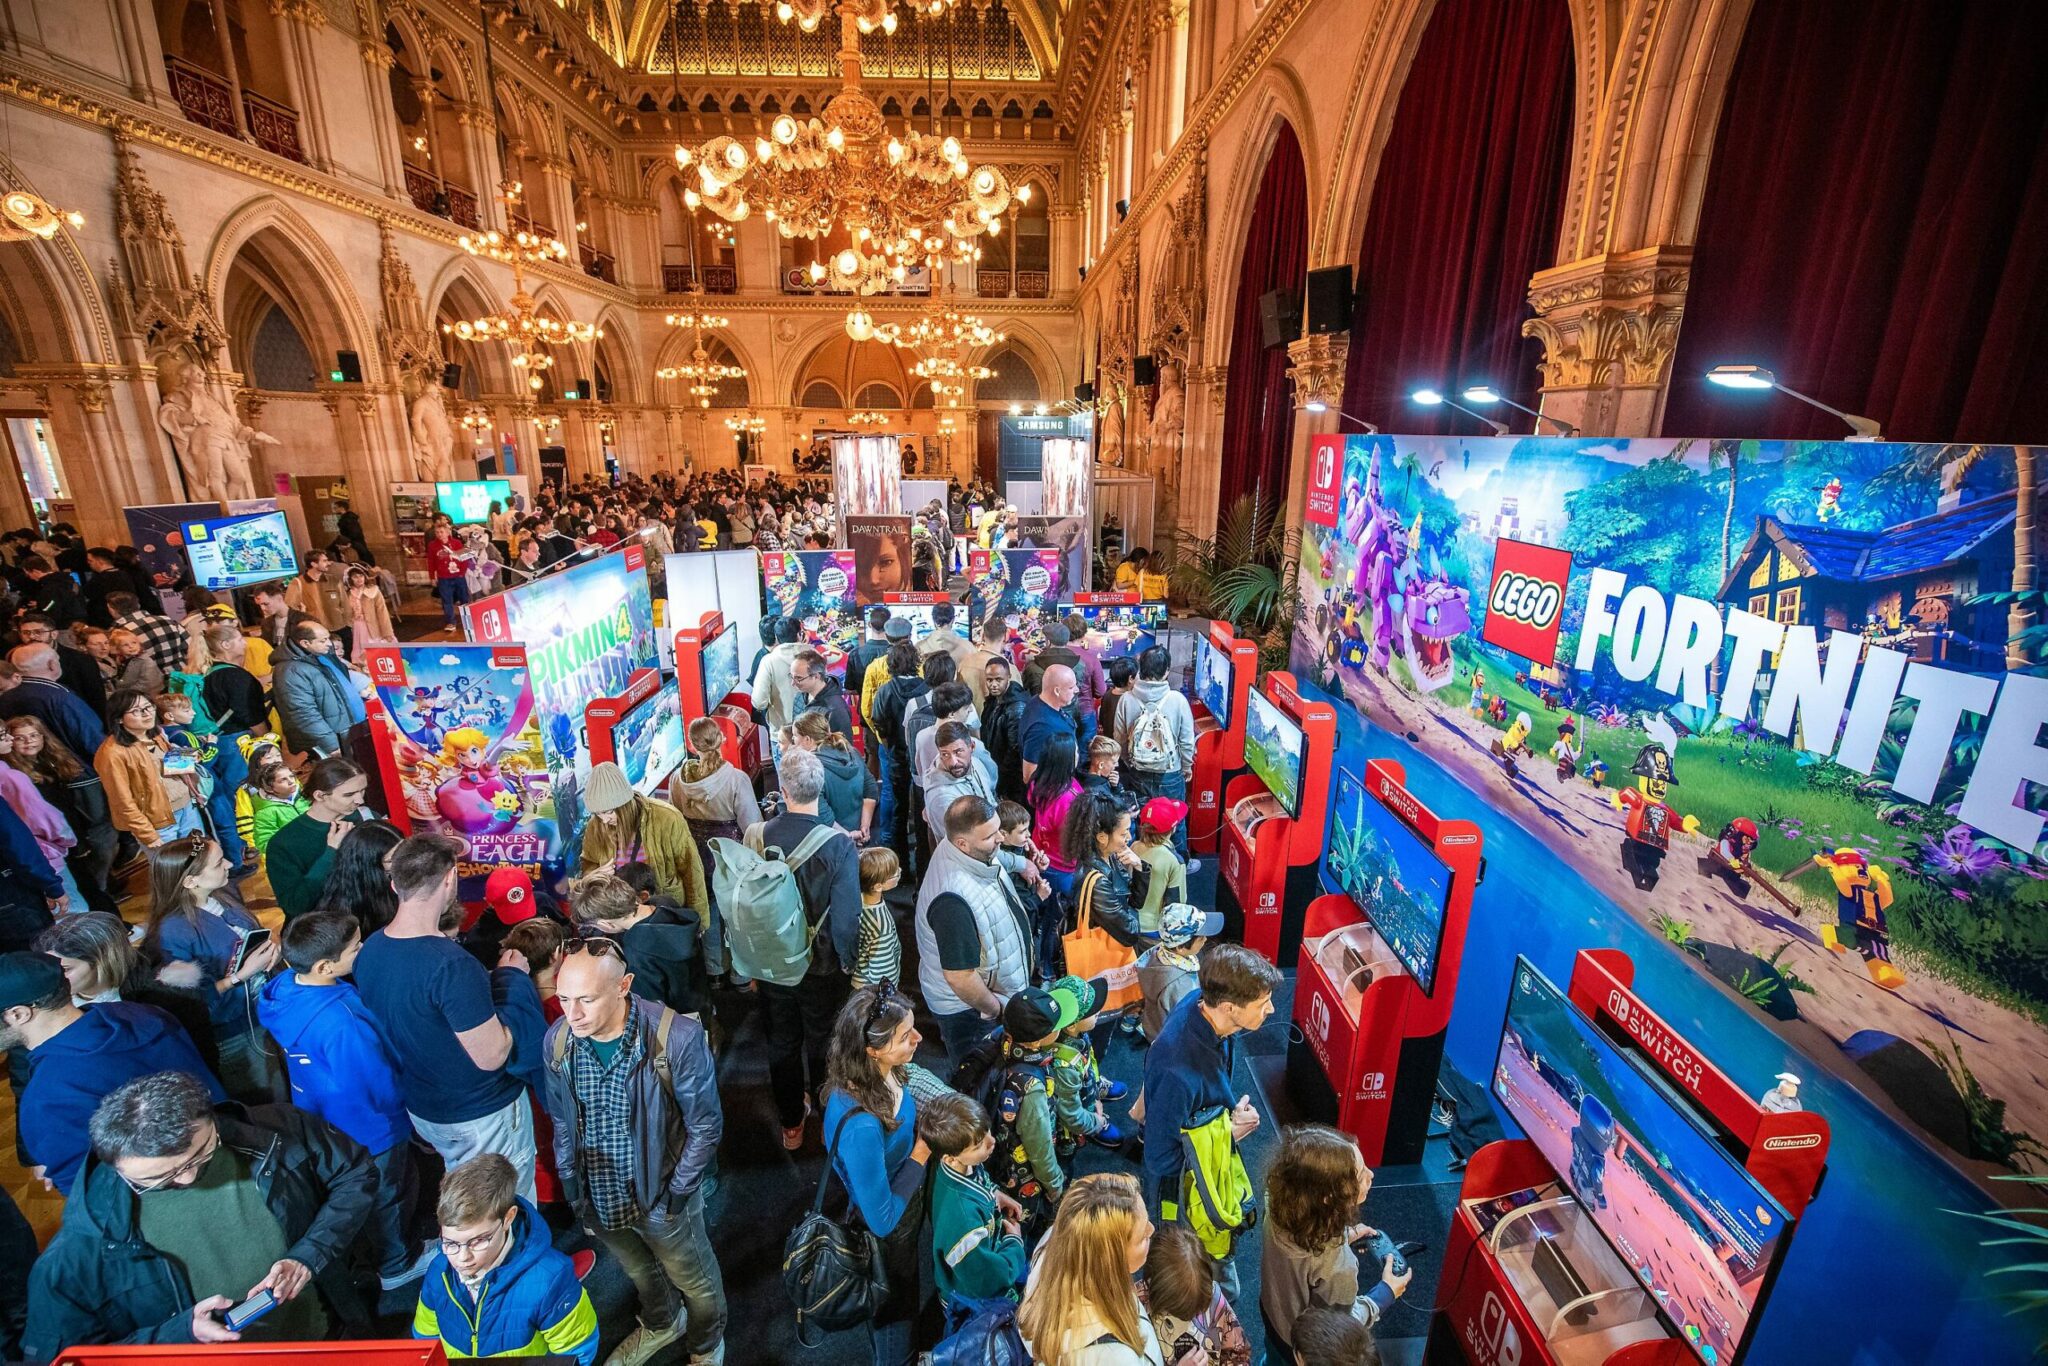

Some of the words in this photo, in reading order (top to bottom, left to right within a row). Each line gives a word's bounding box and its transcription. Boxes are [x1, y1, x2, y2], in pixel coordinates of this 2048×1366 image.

[1018, 421, 1063, 430] SAMSUNG
[1309, 499, 1334, 514] SWITCH
[1311, 491, 1334, 502] NINTENDO
[852, 525, 904, 533] DAWNTRAIL
[1492, 572, 1560, 628] LEGO
[527, 614, 616, 692] PIKMIN
[615, 600, 632, 644] 4
[1575, 567, 2048, 852] FORTNITE
[1389, 792, 1418, 822] SWITCH
[1390, 784, 1419, 812] NINTENDO
[472, 834, 536, 843] PRINCESS
[1628, 1017, 1700, 1092] SWITCH
[1632, 1007, 1703, 1075] NINTENDO
[1768, 1135, 1819, 1148] Nintendo
